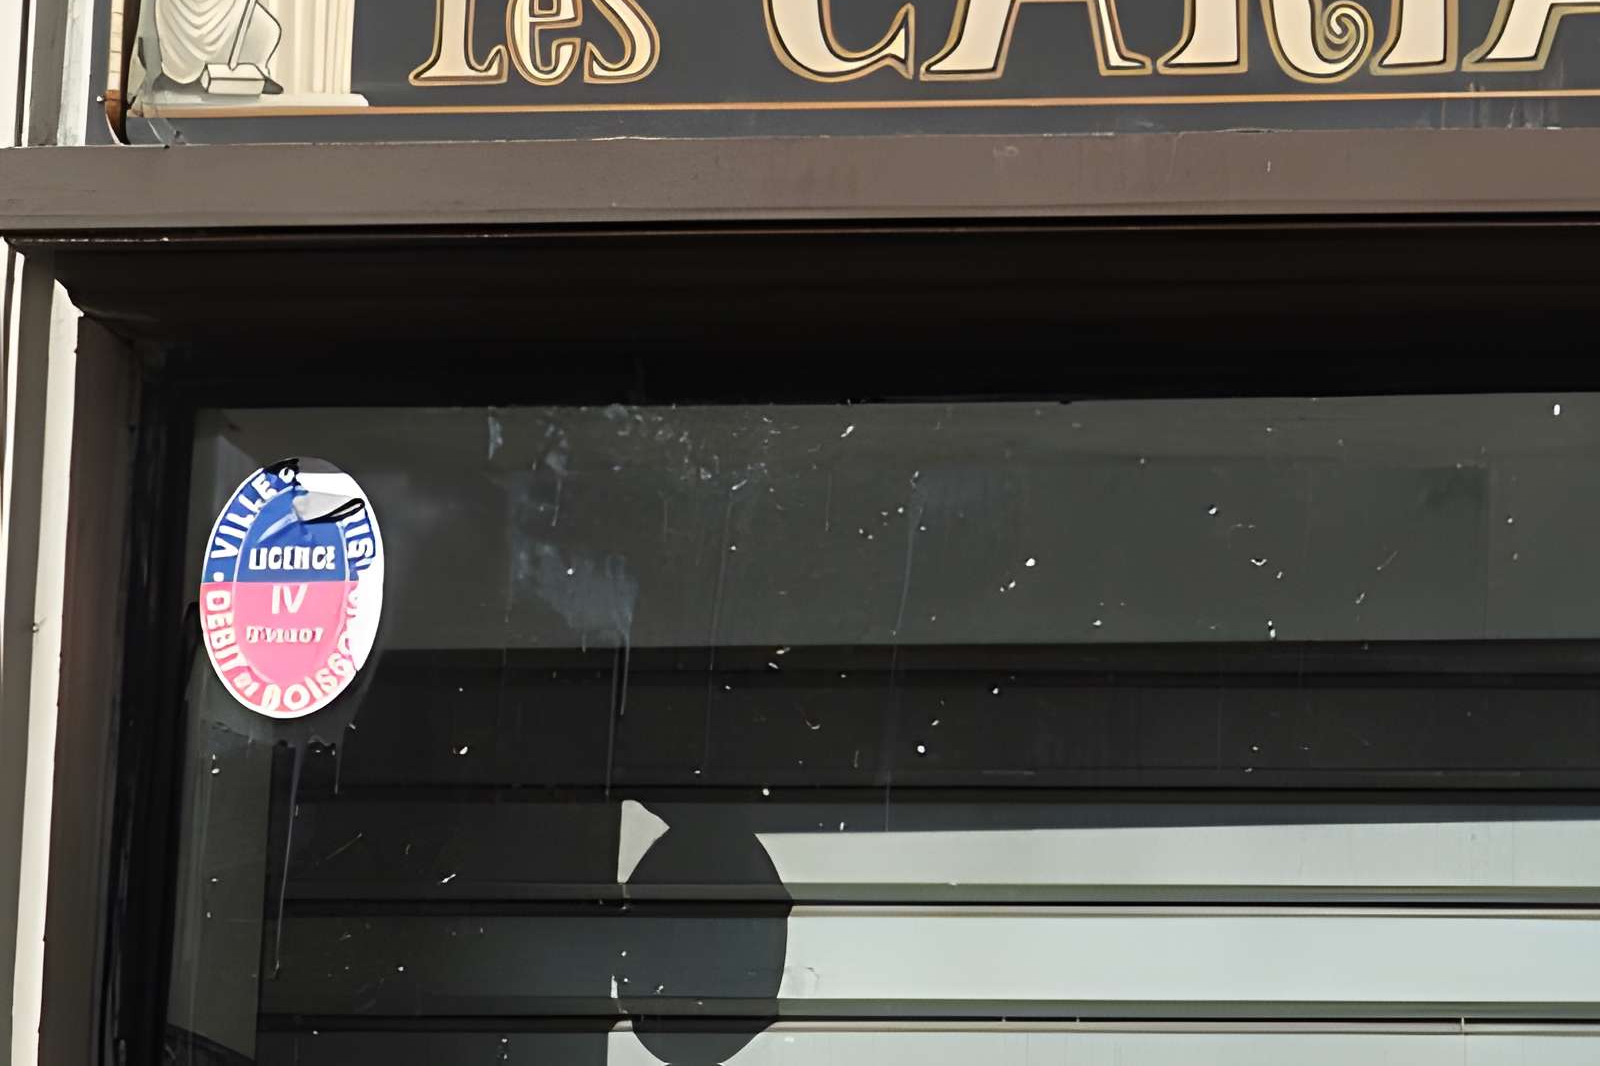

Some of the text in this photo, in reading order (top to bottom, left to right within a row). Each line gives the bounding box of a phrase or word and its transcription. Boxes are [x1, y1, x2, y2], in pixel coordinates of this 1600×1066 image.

[211, 472, 279, 559] VILLE
[248, 545, 337, 571] LICENCE
[271, 584, 309, 615] IV
[205, 589, 249, 672] DEBIT
